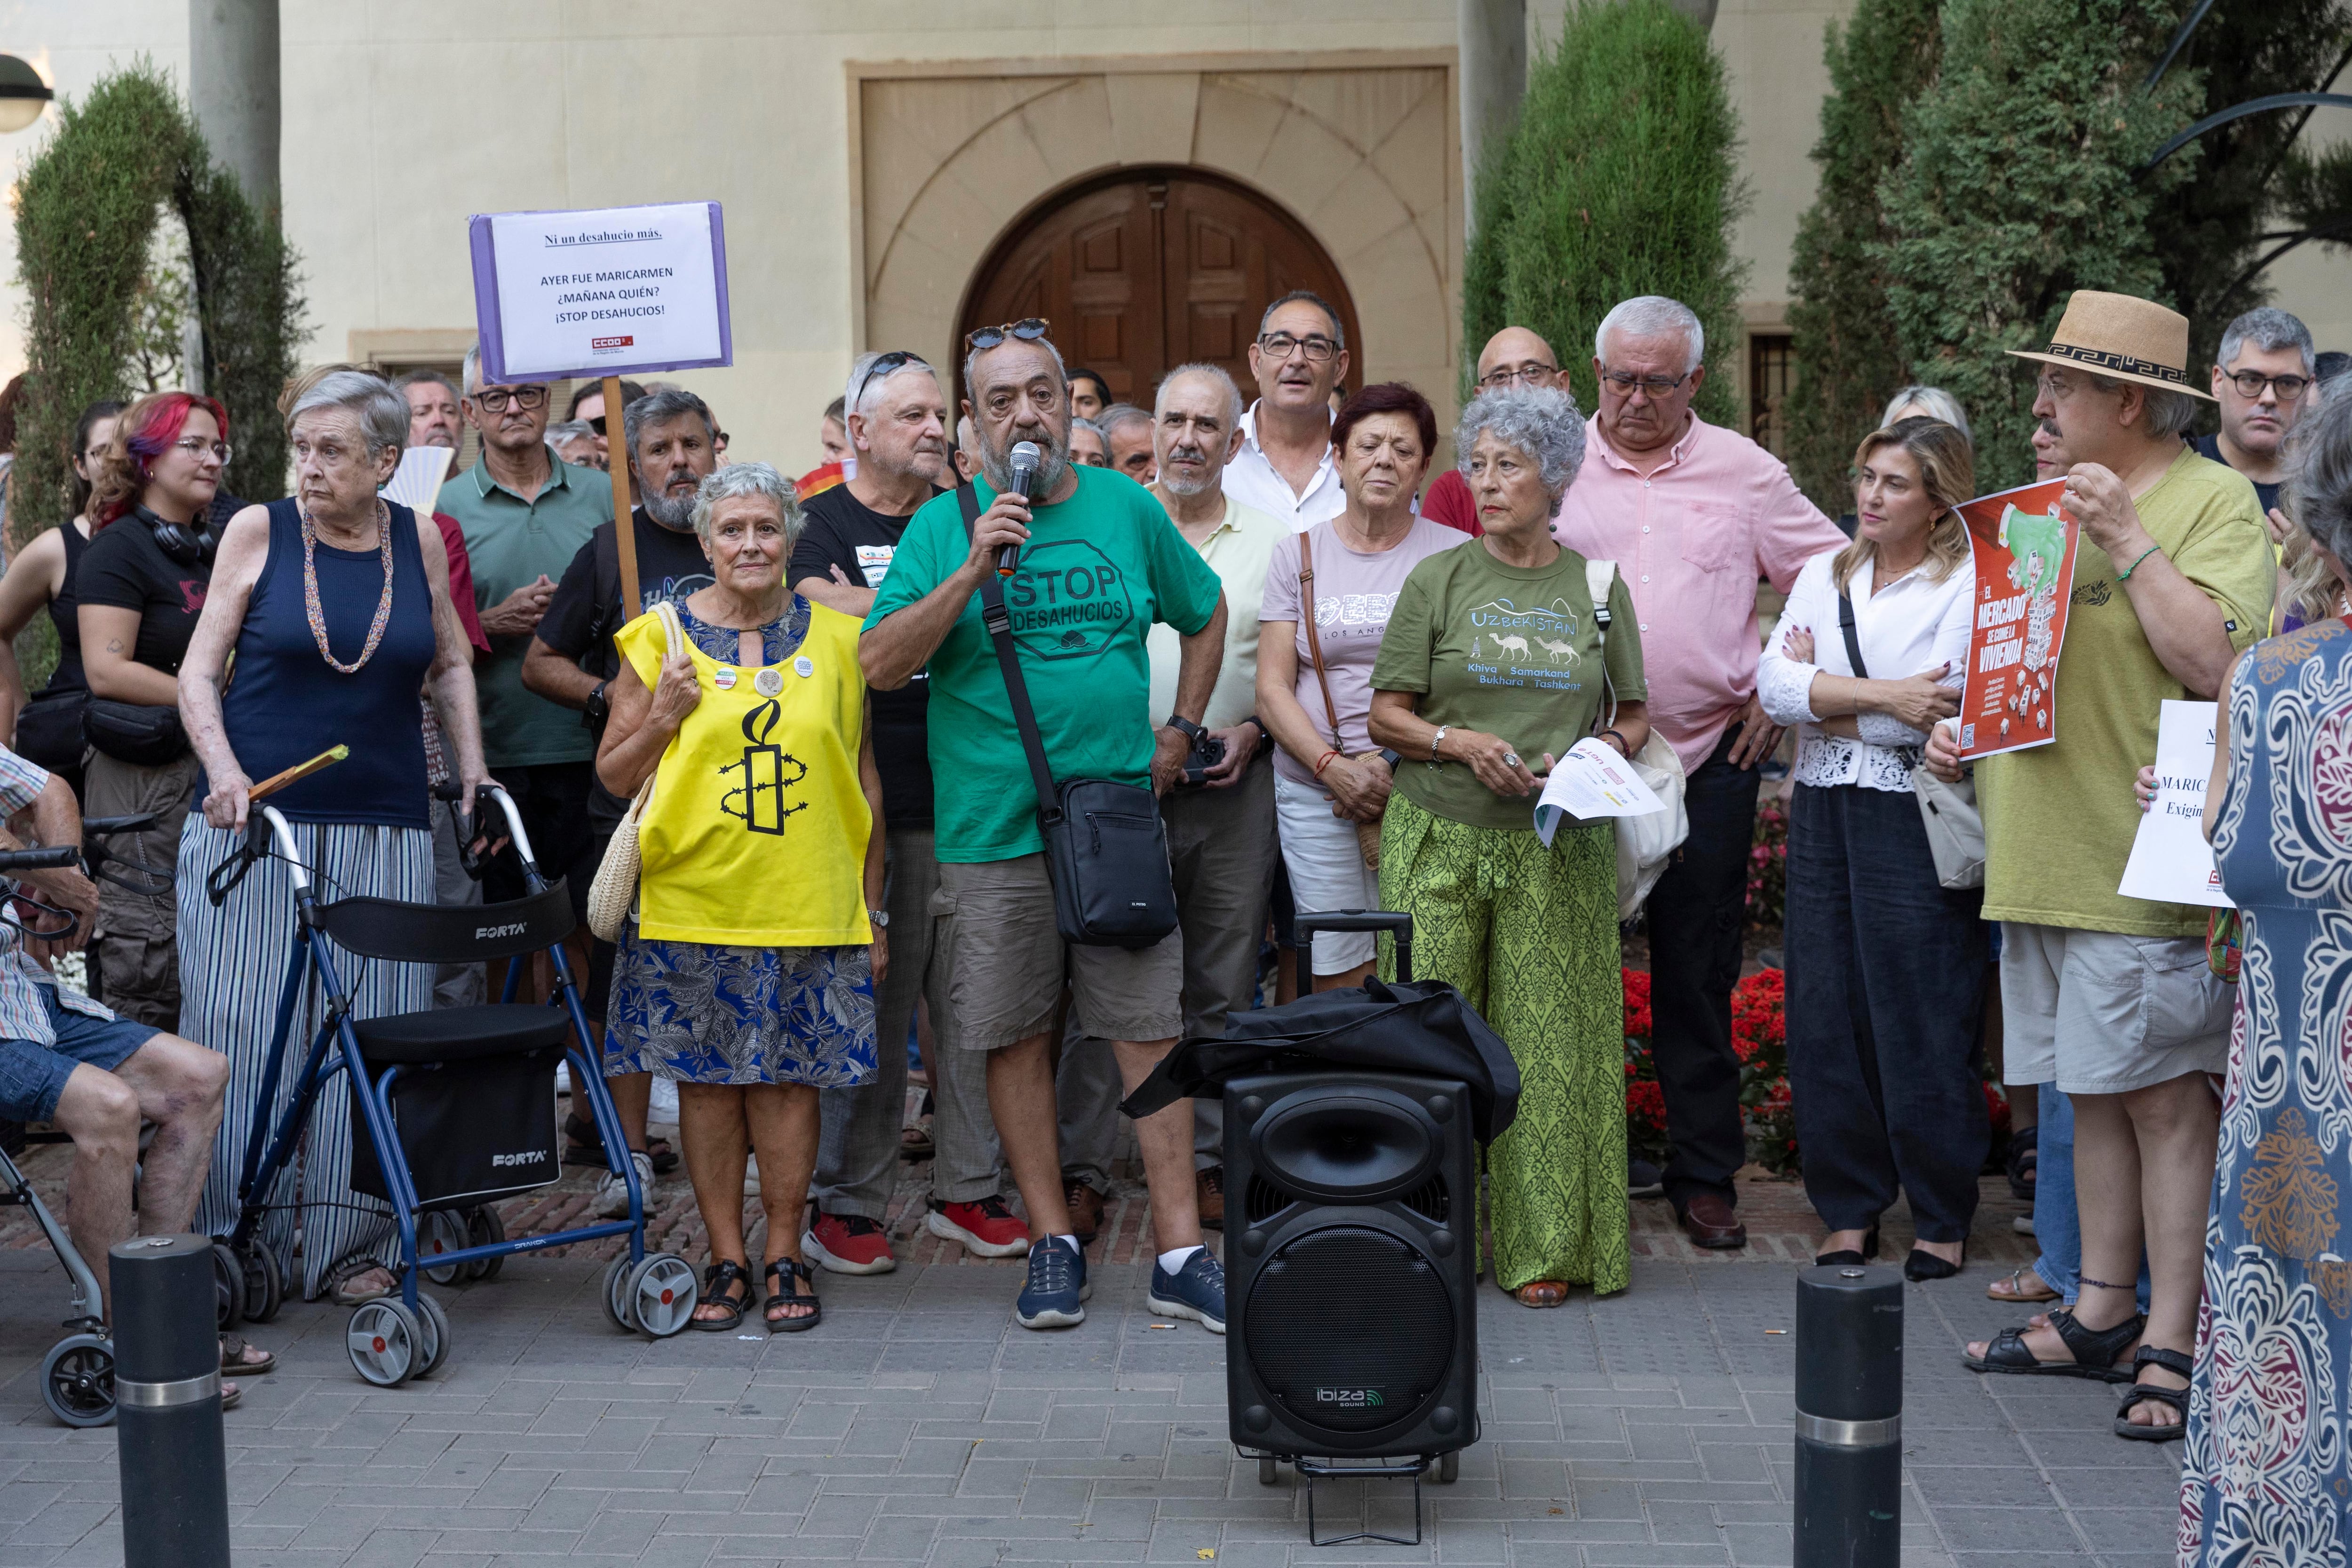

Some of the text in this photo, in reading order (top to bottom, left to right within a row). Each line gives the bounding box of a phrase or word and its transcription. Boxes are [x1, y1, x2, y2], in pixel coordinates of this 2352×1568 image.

[545, 235, 557, 245] Ni
[579, 230, 634, 243] desahucio
[637, 228, 662, 239] más.
[541, 267, 673, 286] AYER FUE MARICARMEN
[558, 286, 660, 305] ¿MAÑANA QUIÉN?
[556, 305, 665, 324] ¡STOP DESAHUCIOS!
[594, 337, 621, 347] CCOO
[1010, 566, 1116, 607] STOP
[1984, 586, 1991, 600] EL
[1013, 600, 1123, 631] DESAHUCIOS
[1977, 594, 2027, 630] MERCADO
[1471, 613, 1575, 635] UZBEKISTAN
[1325, 626, 1384, 639] LOS ANG
[1986, 624, 2016, 644] SE COME LA
[1979, 637, 2024, 674] VIVIENDA
[1468, 663, 1570, 678] Khiva Samarkand
[1479, 675, 1581, 691] Bukhara Tashkent
[2207, 729, 2216, 741] N
[2161, 777, 2209, 792] MARIC
[475, 923, 524, 939] FORTA
[493, 1151, 545, 1167] FORTA
[1317, 1388, 1365, 1401] ibiza
